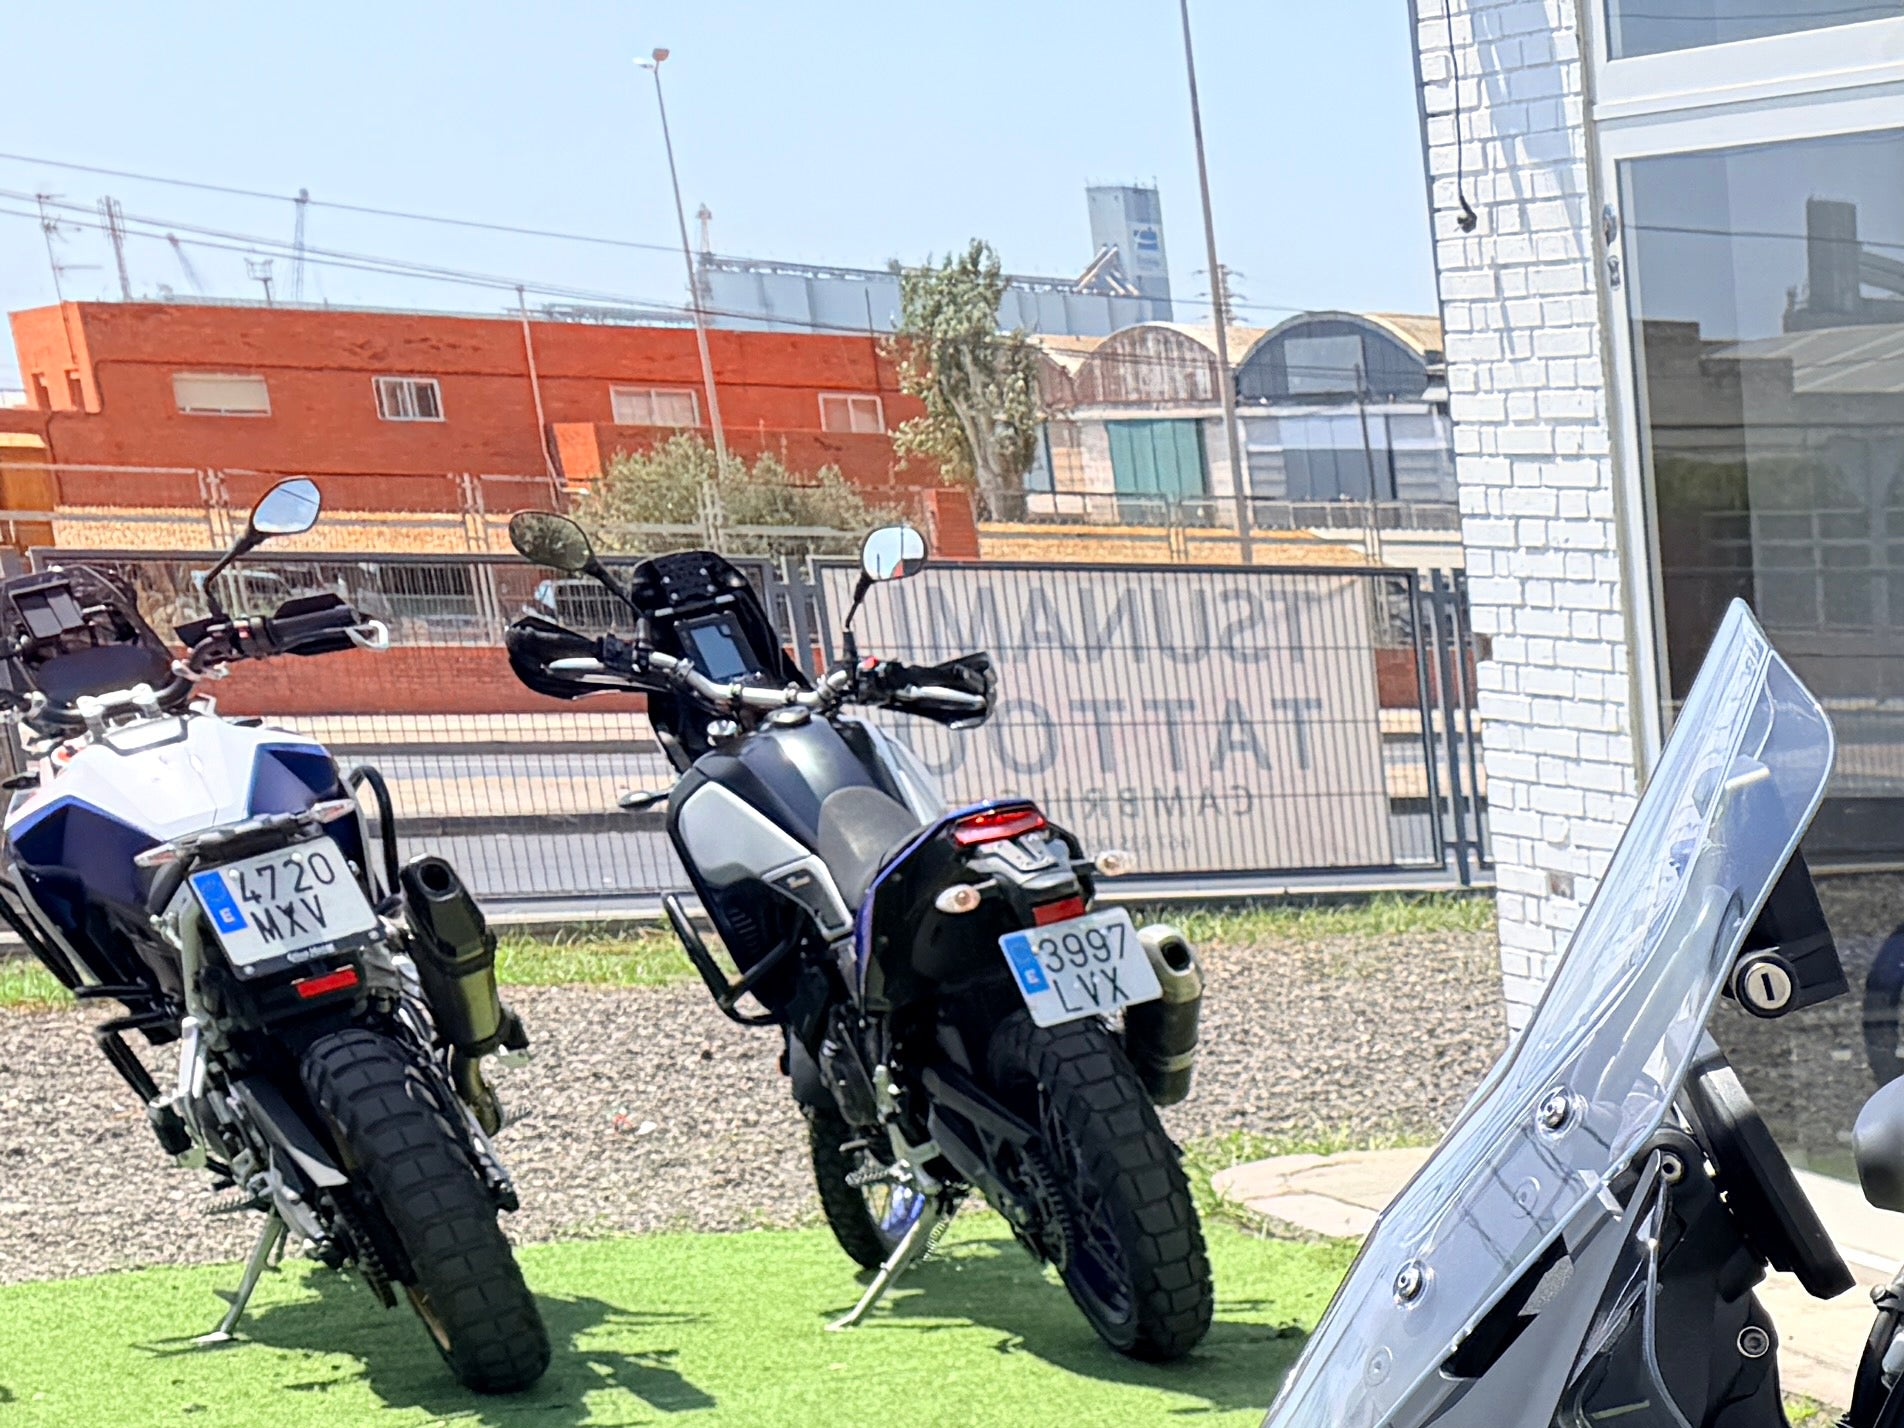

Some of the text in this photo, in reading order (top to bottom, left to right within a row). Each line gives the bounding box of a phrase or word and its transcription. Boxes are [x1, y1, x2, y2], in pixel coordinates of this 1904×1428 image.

[237, 851, 336, 904] 4720
[250, 894, 327, 944] MXV
[1039, 922, 1125, 973] 3997
[1052, 966, 1131, 1013] LVX
